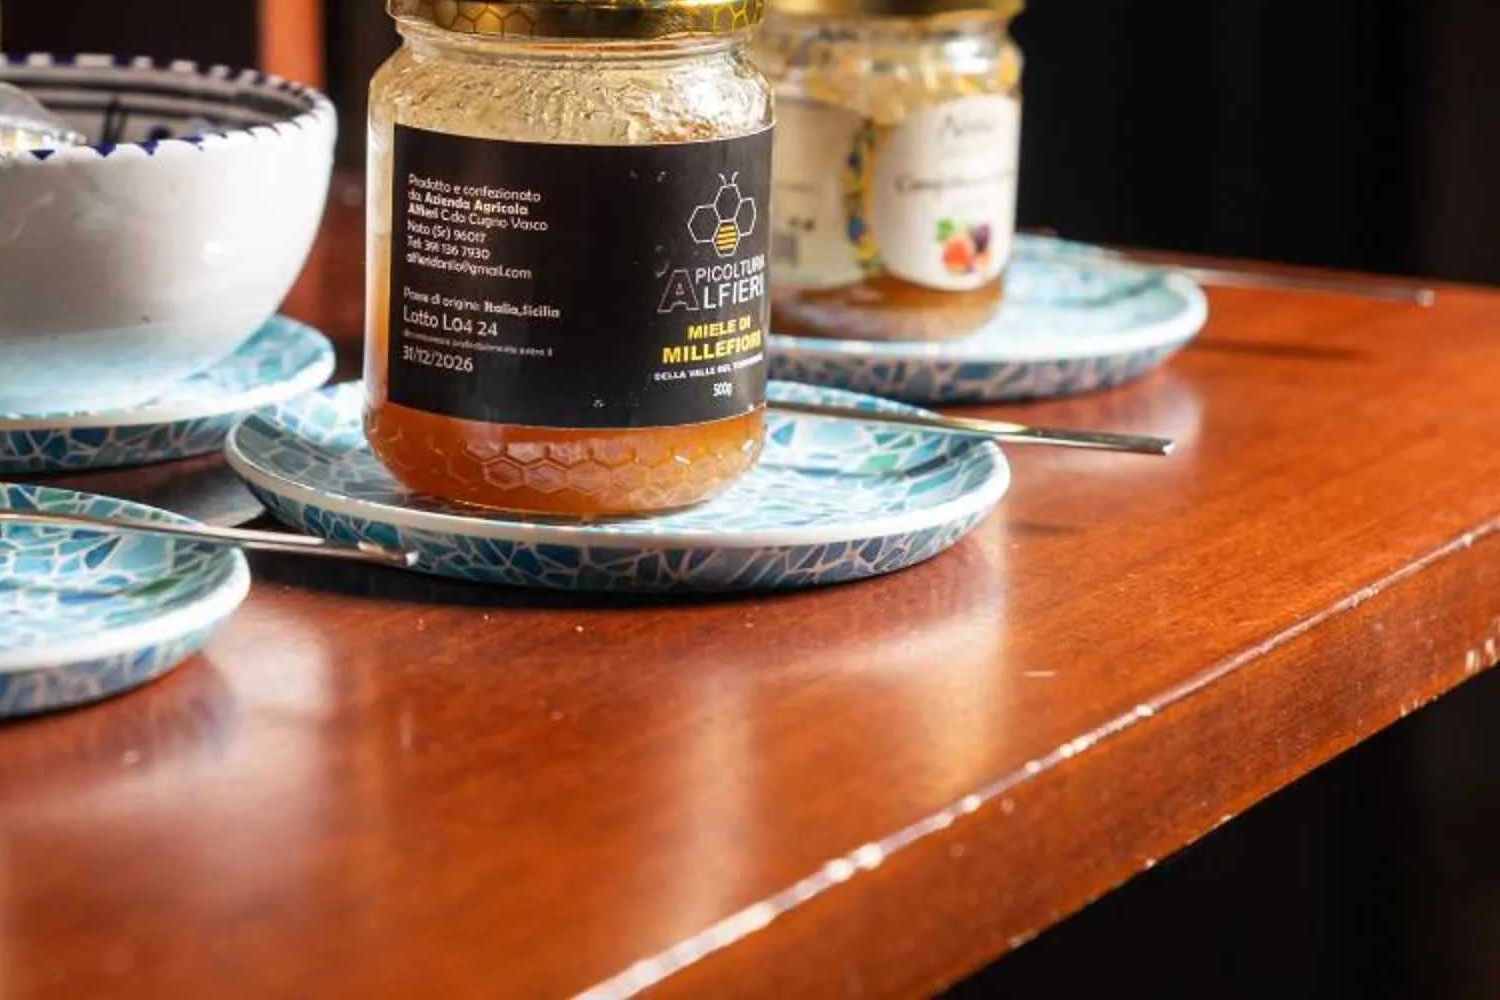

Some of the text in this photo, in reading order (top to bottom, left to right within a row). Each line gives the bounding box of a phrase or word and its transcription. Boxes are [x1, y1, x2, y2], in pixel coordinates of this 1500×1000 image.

[408, 173, 450, 192] Prodotto
[463, 185, 541, 202] confezionato
[424, 192, 470, 209] Azienda
[474, 199, 529, 215] Agricola
[407, 220, 430, 234] Noto
[468, 213, 508, 228] Cugno
[511, 218, 549, 231] Vasco
[462, 246, 490, 260] 7930
[403, 305, 439, 327] Lotto
[476, 321, 498, 336] 24
[687, 315, 751, 340] MIELE DI
[402, 345, 474, 372] 31/12/2026
[662, 329, 762, 364] MILLEFIORI
[654, 368, 687, 381] DELLA
